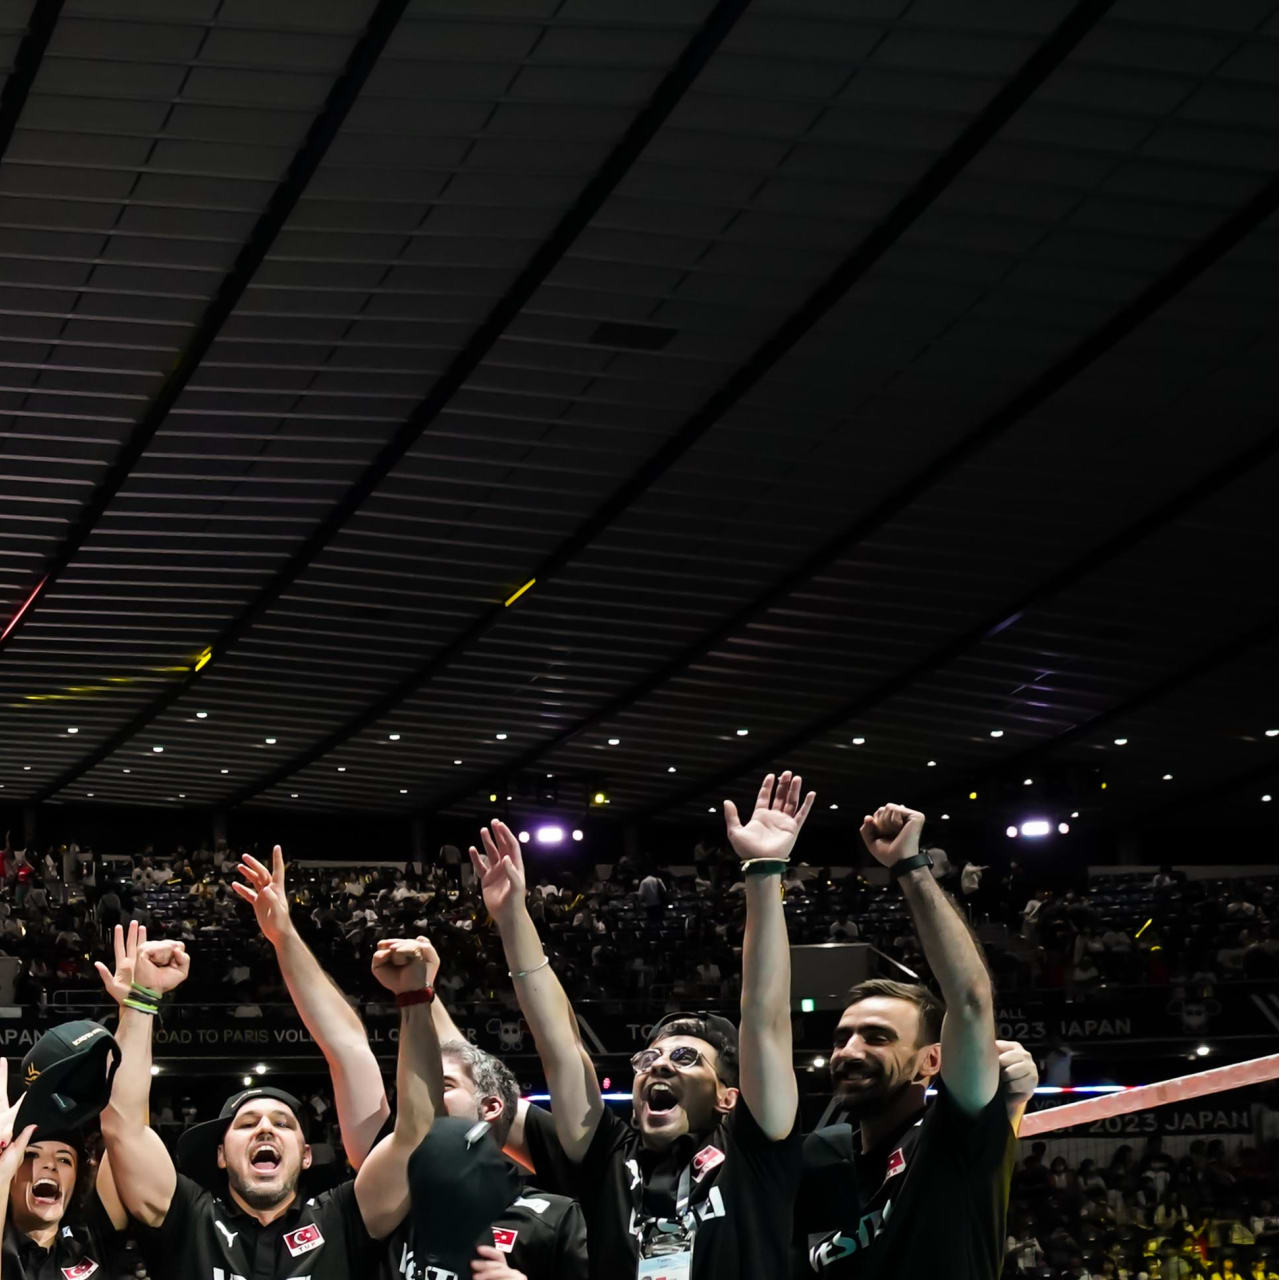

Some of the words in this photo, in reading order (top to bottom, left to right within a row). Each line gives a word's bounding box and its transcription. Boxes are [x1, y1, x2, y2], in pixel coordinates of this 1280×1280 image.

[199, 1029, 219, 1044] TO
[223, 1029, 270, 1043] PARIS
[1163, 1110, 1250, 1131] JAPAN
